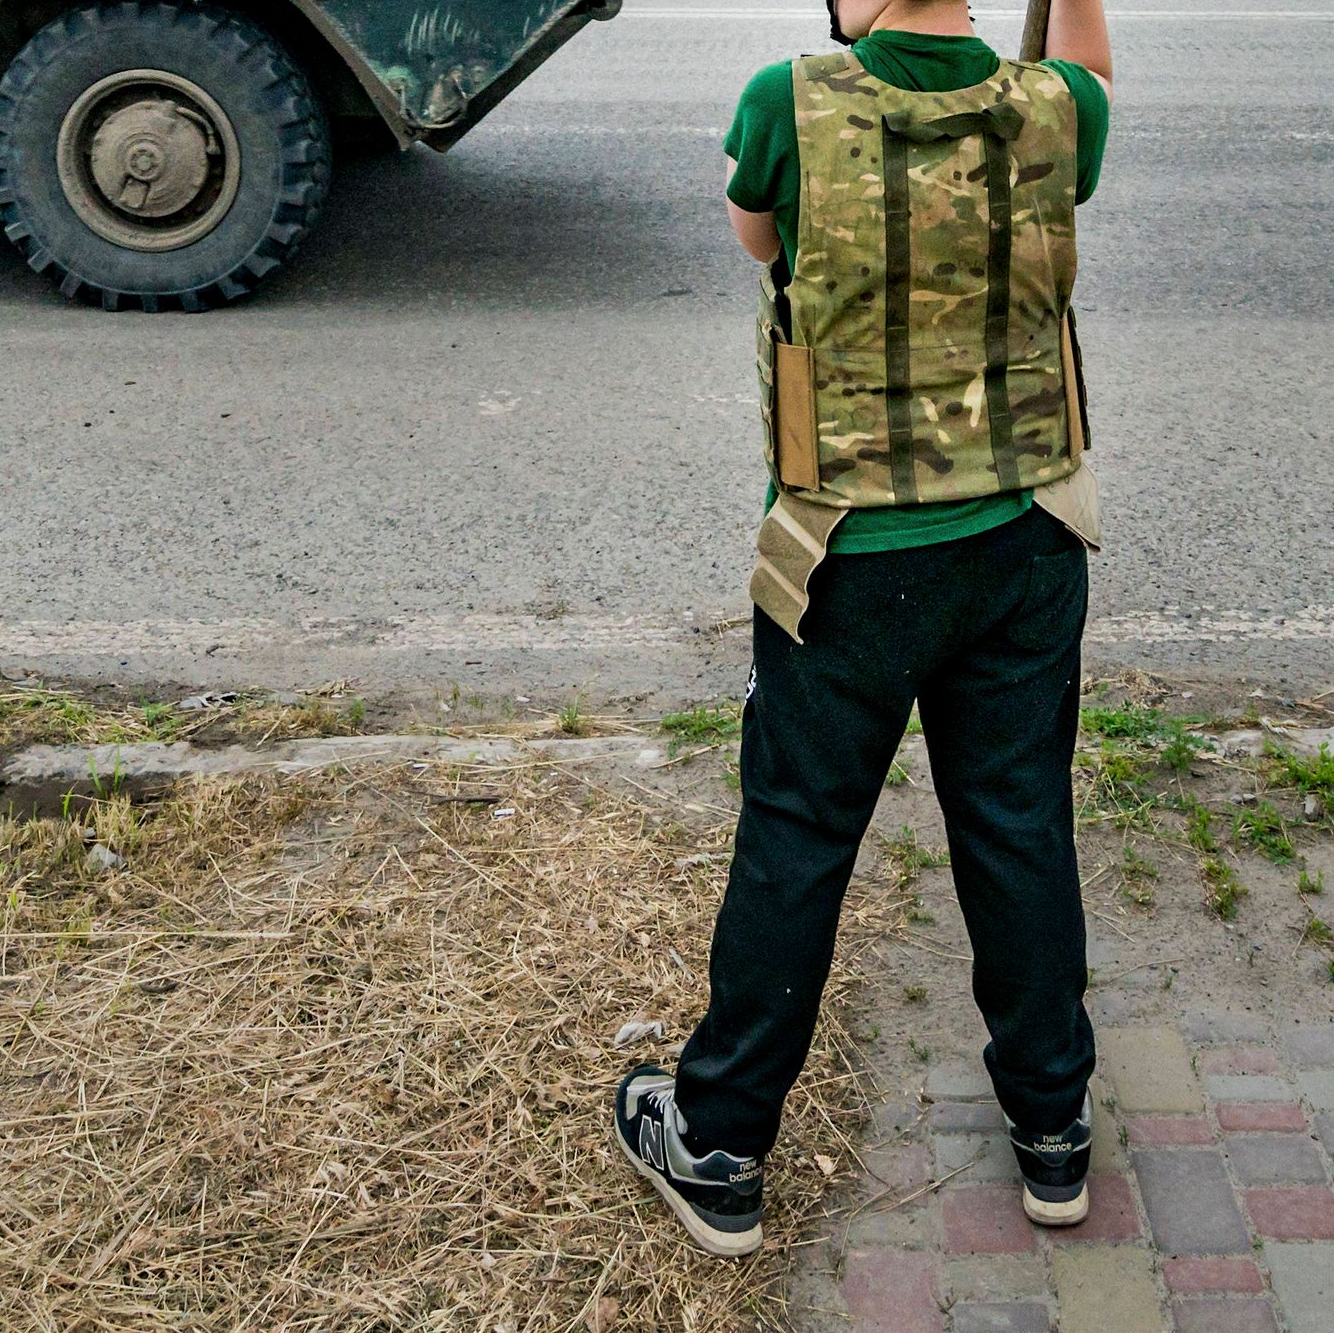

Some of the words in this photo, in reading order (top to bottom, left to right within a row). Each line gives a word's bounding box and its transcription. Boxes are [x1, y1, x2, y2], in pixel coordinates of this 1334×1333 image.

[639, 1114, 665, 1171] N
[1042, 1134, 1063, 1144] new
[1033, 1141, 1073, 1153] balance
[739, 1159, 757, 1172] new
